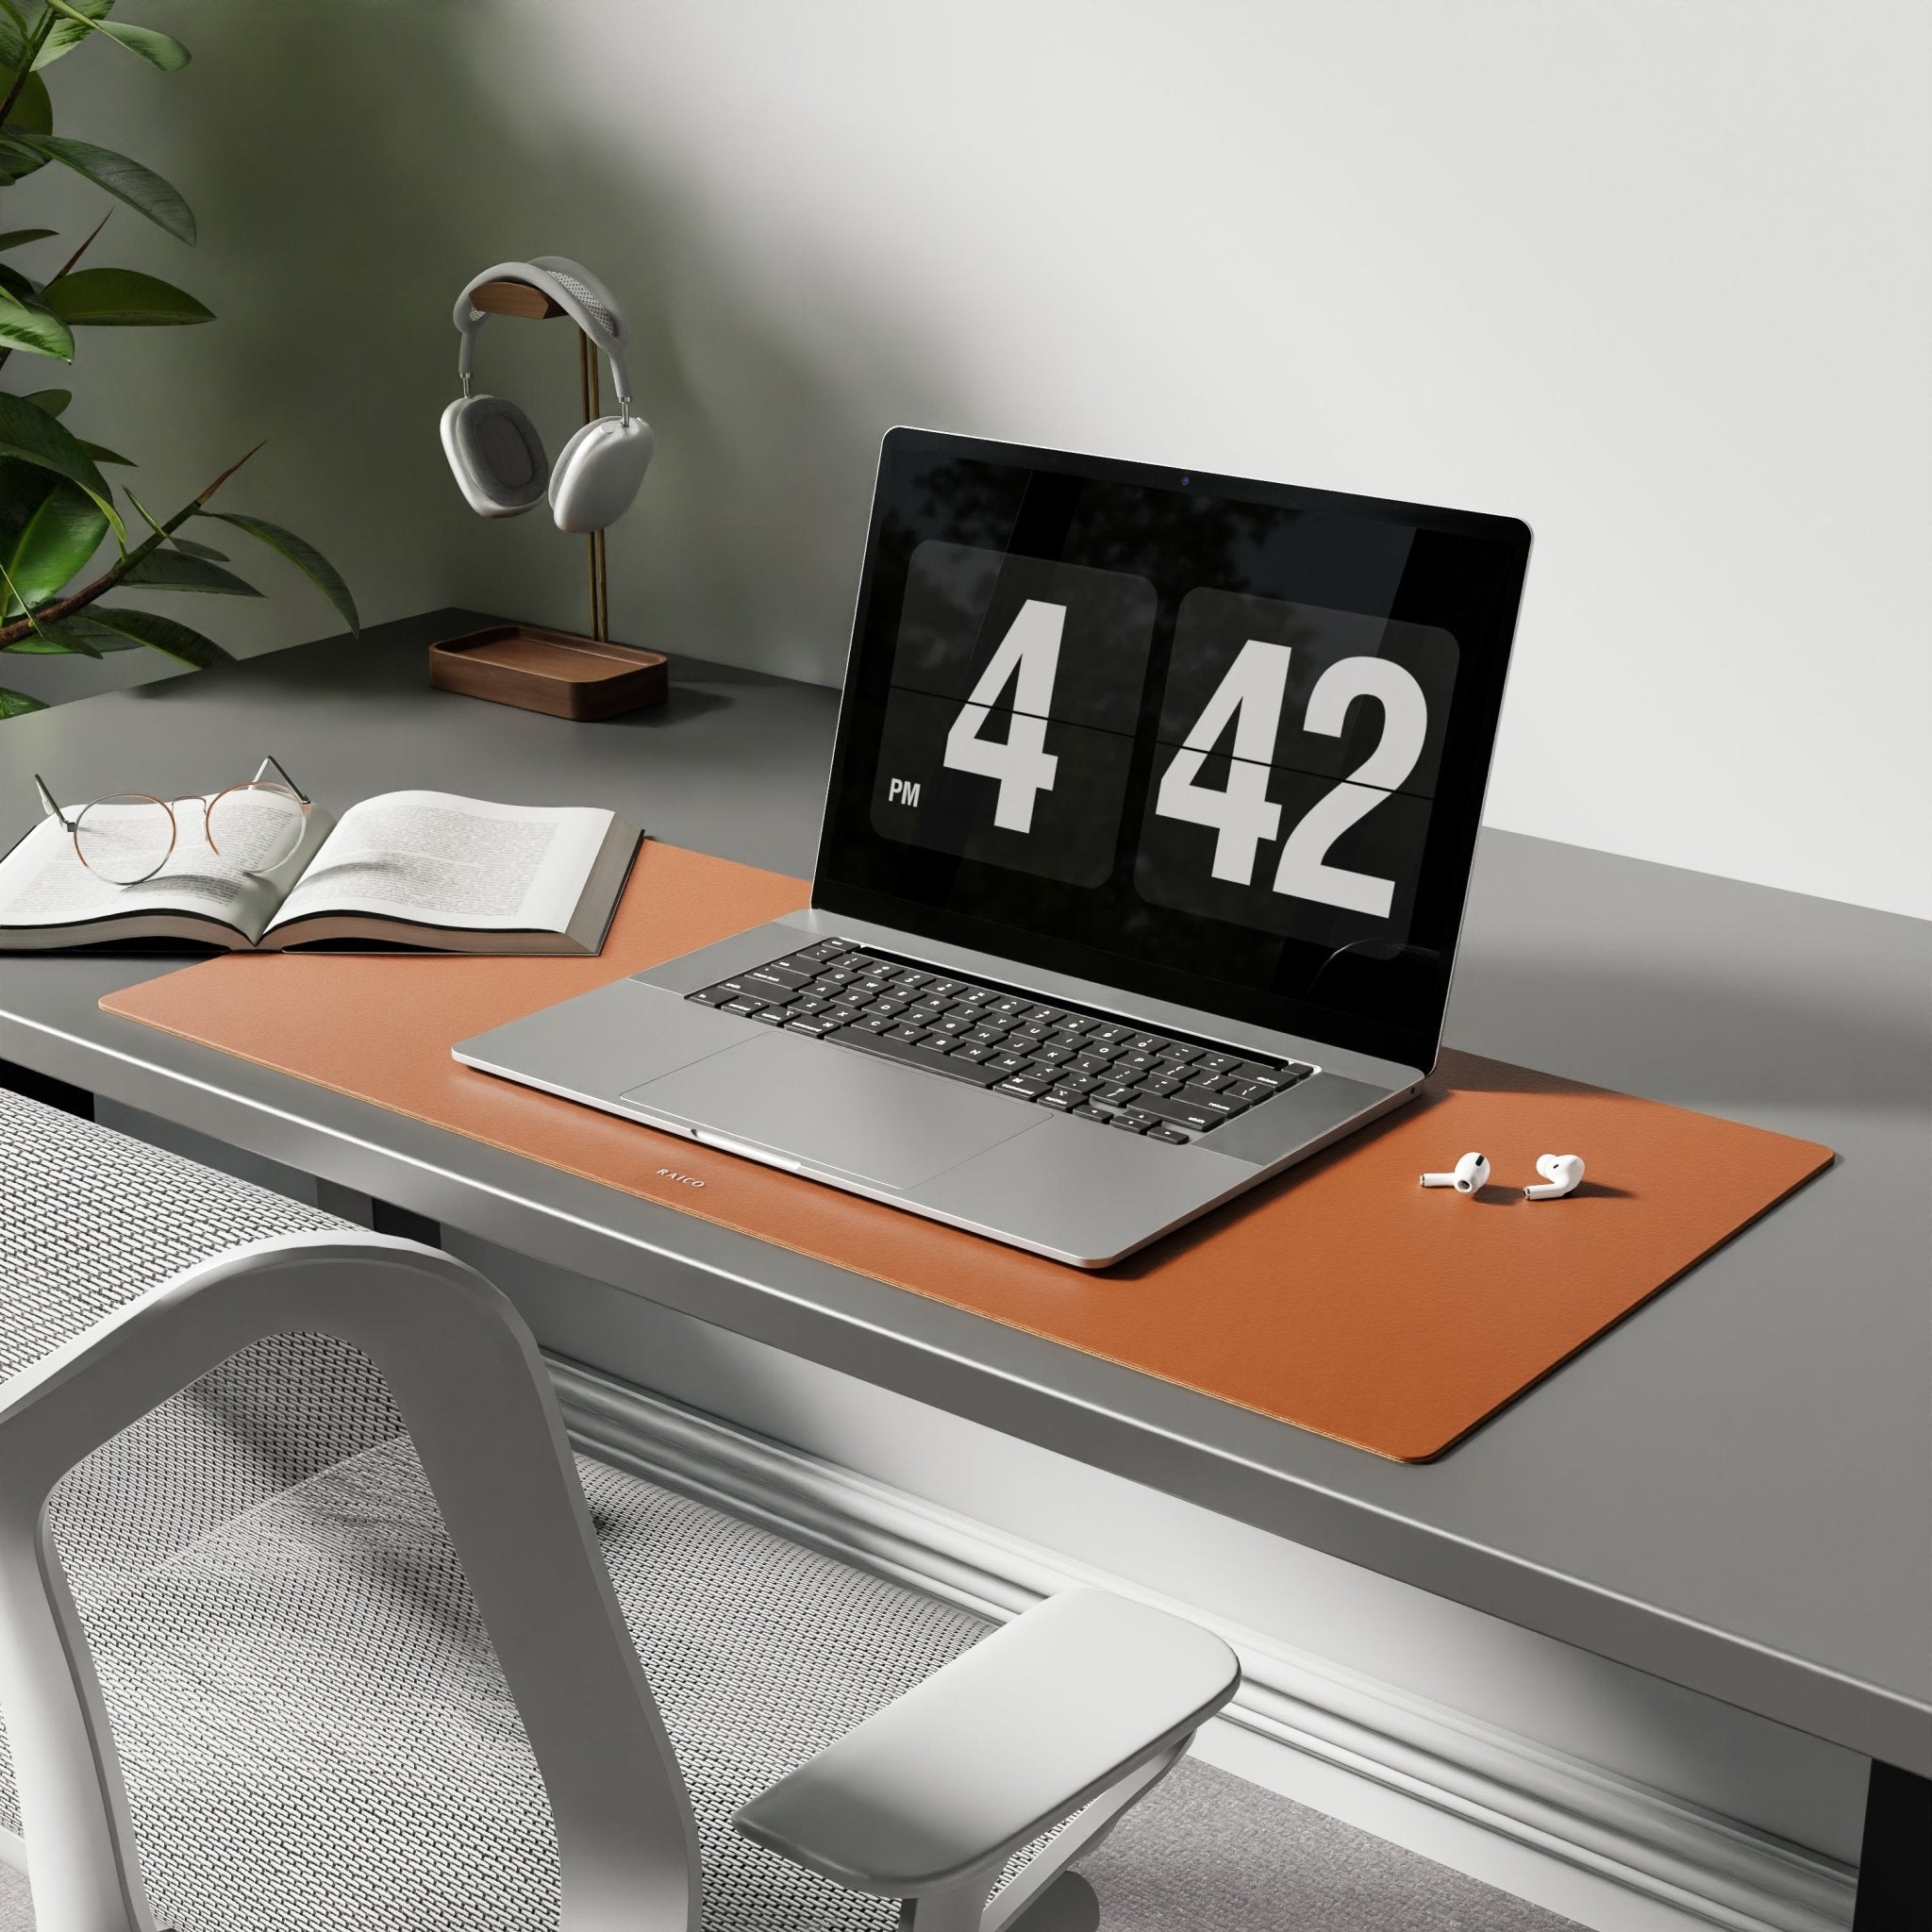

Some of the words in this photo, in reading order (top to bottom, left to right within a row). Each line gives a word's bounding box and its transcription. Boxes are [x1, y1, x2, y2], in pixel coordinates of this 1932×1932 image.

[943, 598, 1067, 834] 4
[1156, 639, 1427, 919] 42
[888, 777, 921, 808] PM
[656, 1168, 705, 1188] RAICO
